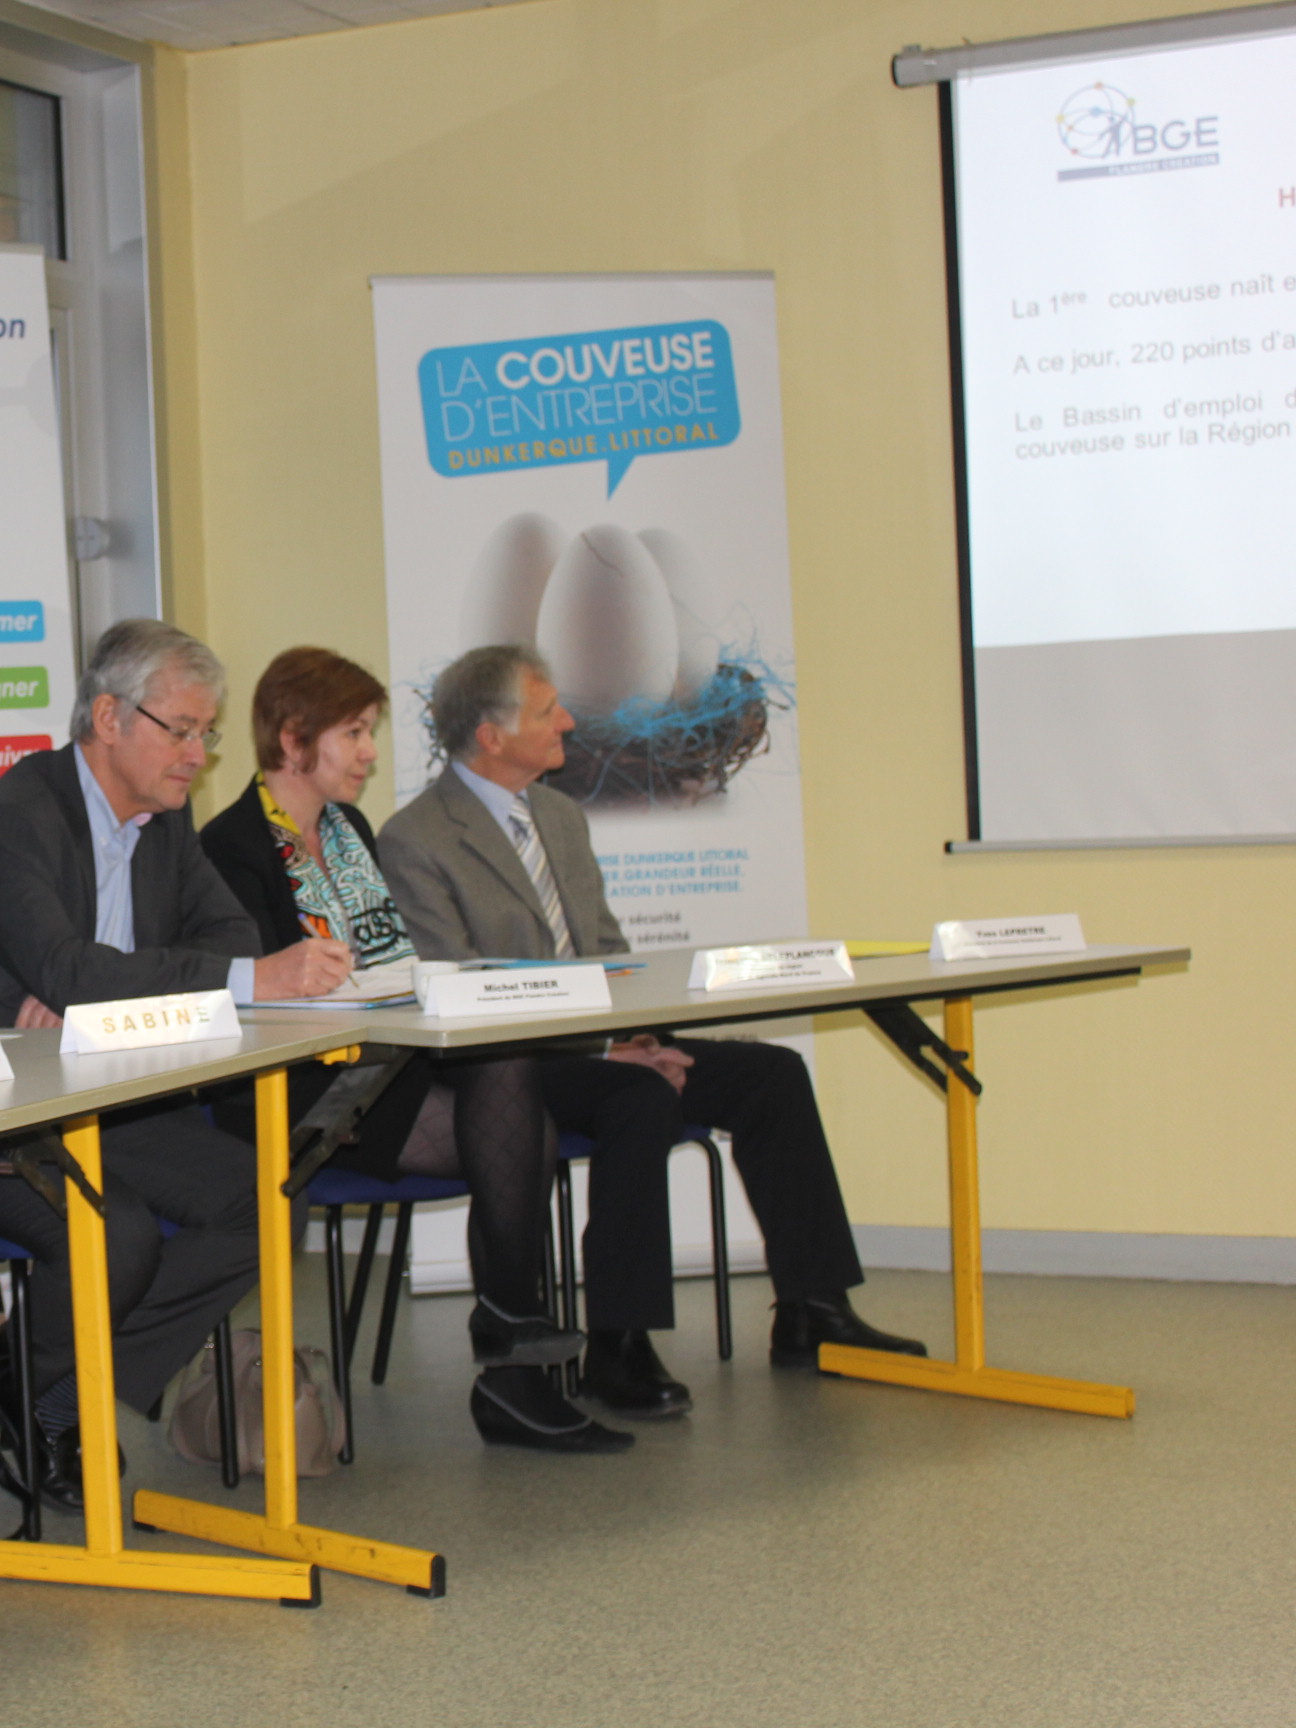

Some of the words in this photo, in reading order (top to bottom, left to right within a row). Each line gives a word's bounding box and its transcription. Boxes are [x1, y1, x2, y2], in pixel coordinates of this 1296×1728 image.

[1132, 116, 1219, 155] BGE
[1012, 299, 1040, 319] La
[1108, 283, 1221, 309] couveuse
[436, 357, 488, 397] LA
[496, 332, 715, 389] COUVEUSE
[1013, 354, 1030, 375] A
[1037, 355, 1064, 373] ce
[1071, 350, 1120, 375] jour,
[1131, 341, 1174, 364] 220
[1182, 336, 1251, 364] points
[441, 373, 718, 442] D'ENTREPRISE
[1015, 412, 1043, 432] Le
[1063, 402, 1142, 428] Bassin
[1163, 391, 1263, 419] d'emploi
[1015, 433, 1125, 460] couveuse
[1134, 430, 1171, 448] sur
[1179, 426, 1198, 445] la
[1207, 420, 1290, 446] Région
[625, 867, 695, 881] GRANDEUR
[629, 911, 681, 925] sécurité
[637, 931, 690, 945] sérénité
[102, 1006, 211, 1035] SABINE
